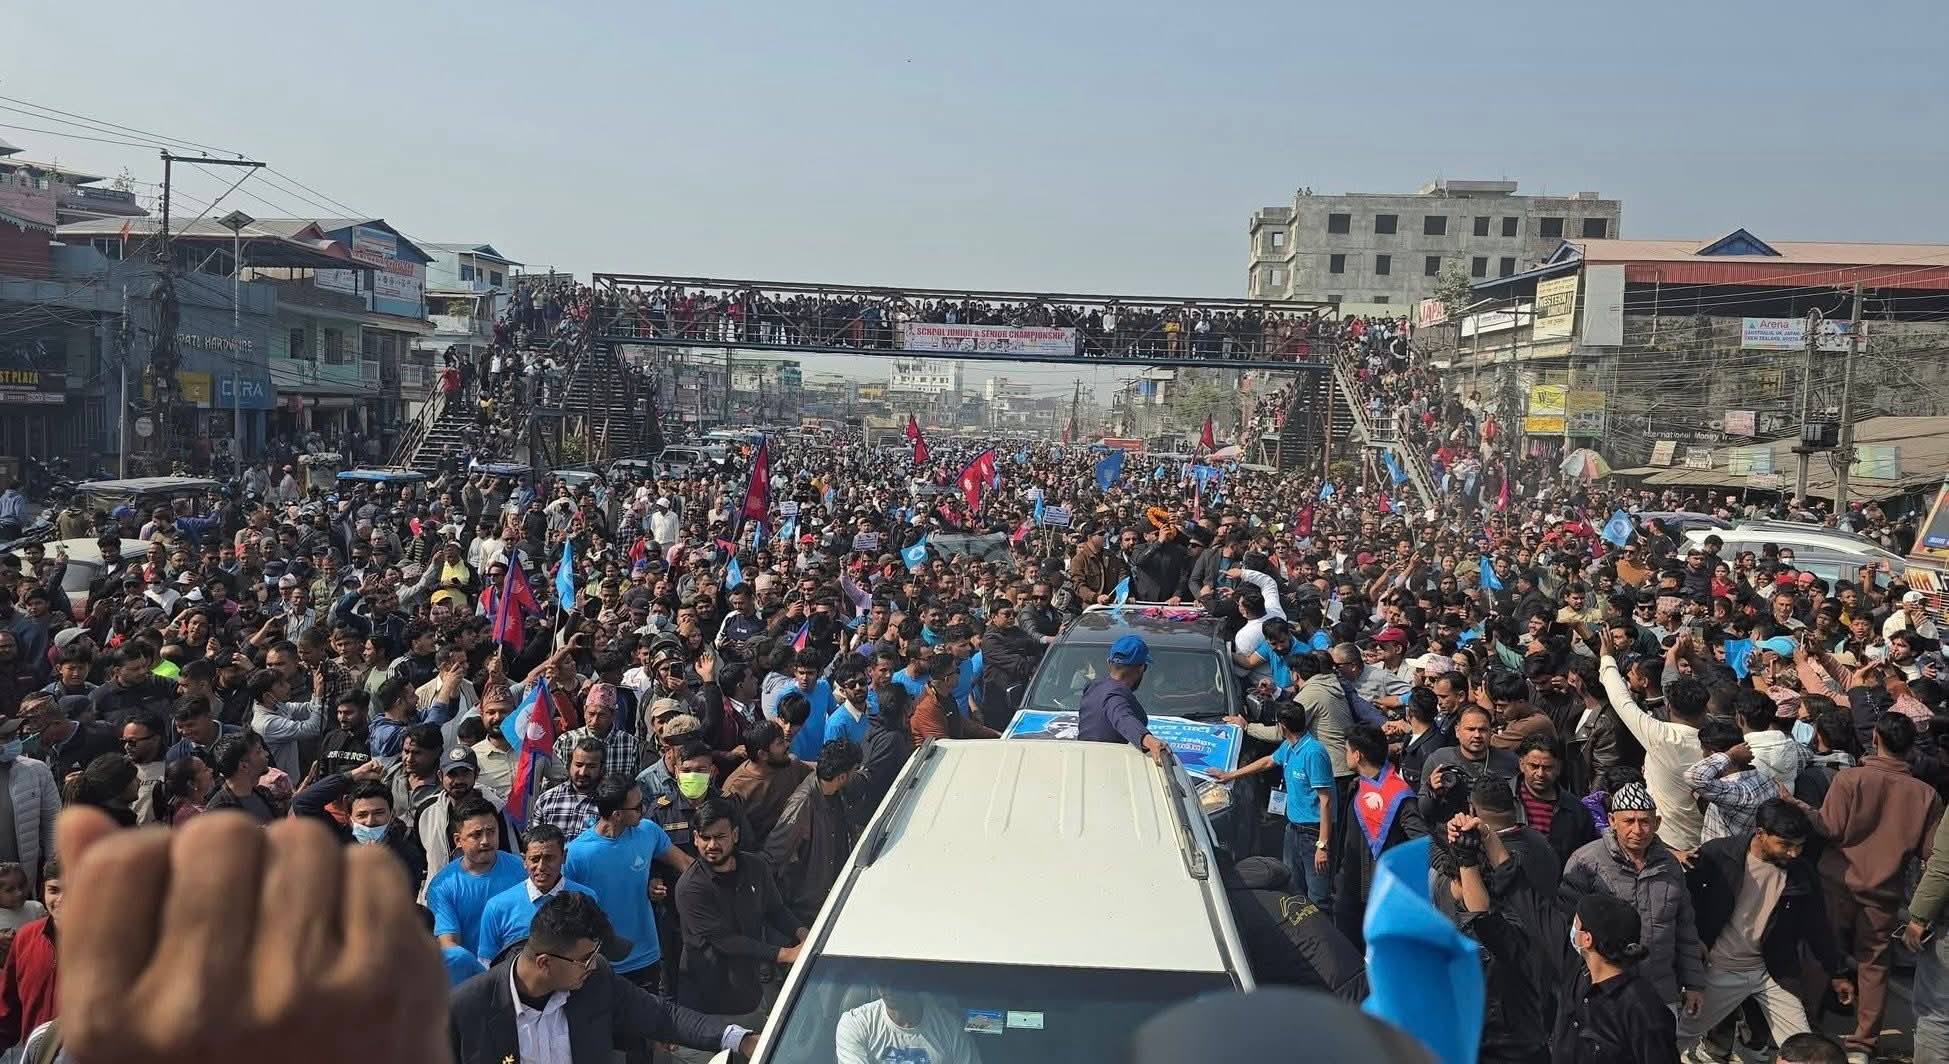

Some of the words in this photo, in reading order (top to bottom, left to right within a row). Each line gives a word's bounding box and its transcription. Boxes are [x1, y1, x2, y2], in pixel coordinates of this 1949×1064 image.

[1539, 292, 1568, 308] WESTERN
[1420, 302, 1443, 322] JAPA
[1760, 319, 1789, 329] Arena
[916, 327, 945, 337] SCHOOL
[945, 328, 973, 338] JUNIOR
[980, 330, 1008, 339] SENIOR
[1008, 330, 1065, 341] CHAMPIONSHIP
[11, 369, 39, 384] PLAZA
[1642, 430, 1691, 440] International
[1694, 431, 1719, 442] Money
